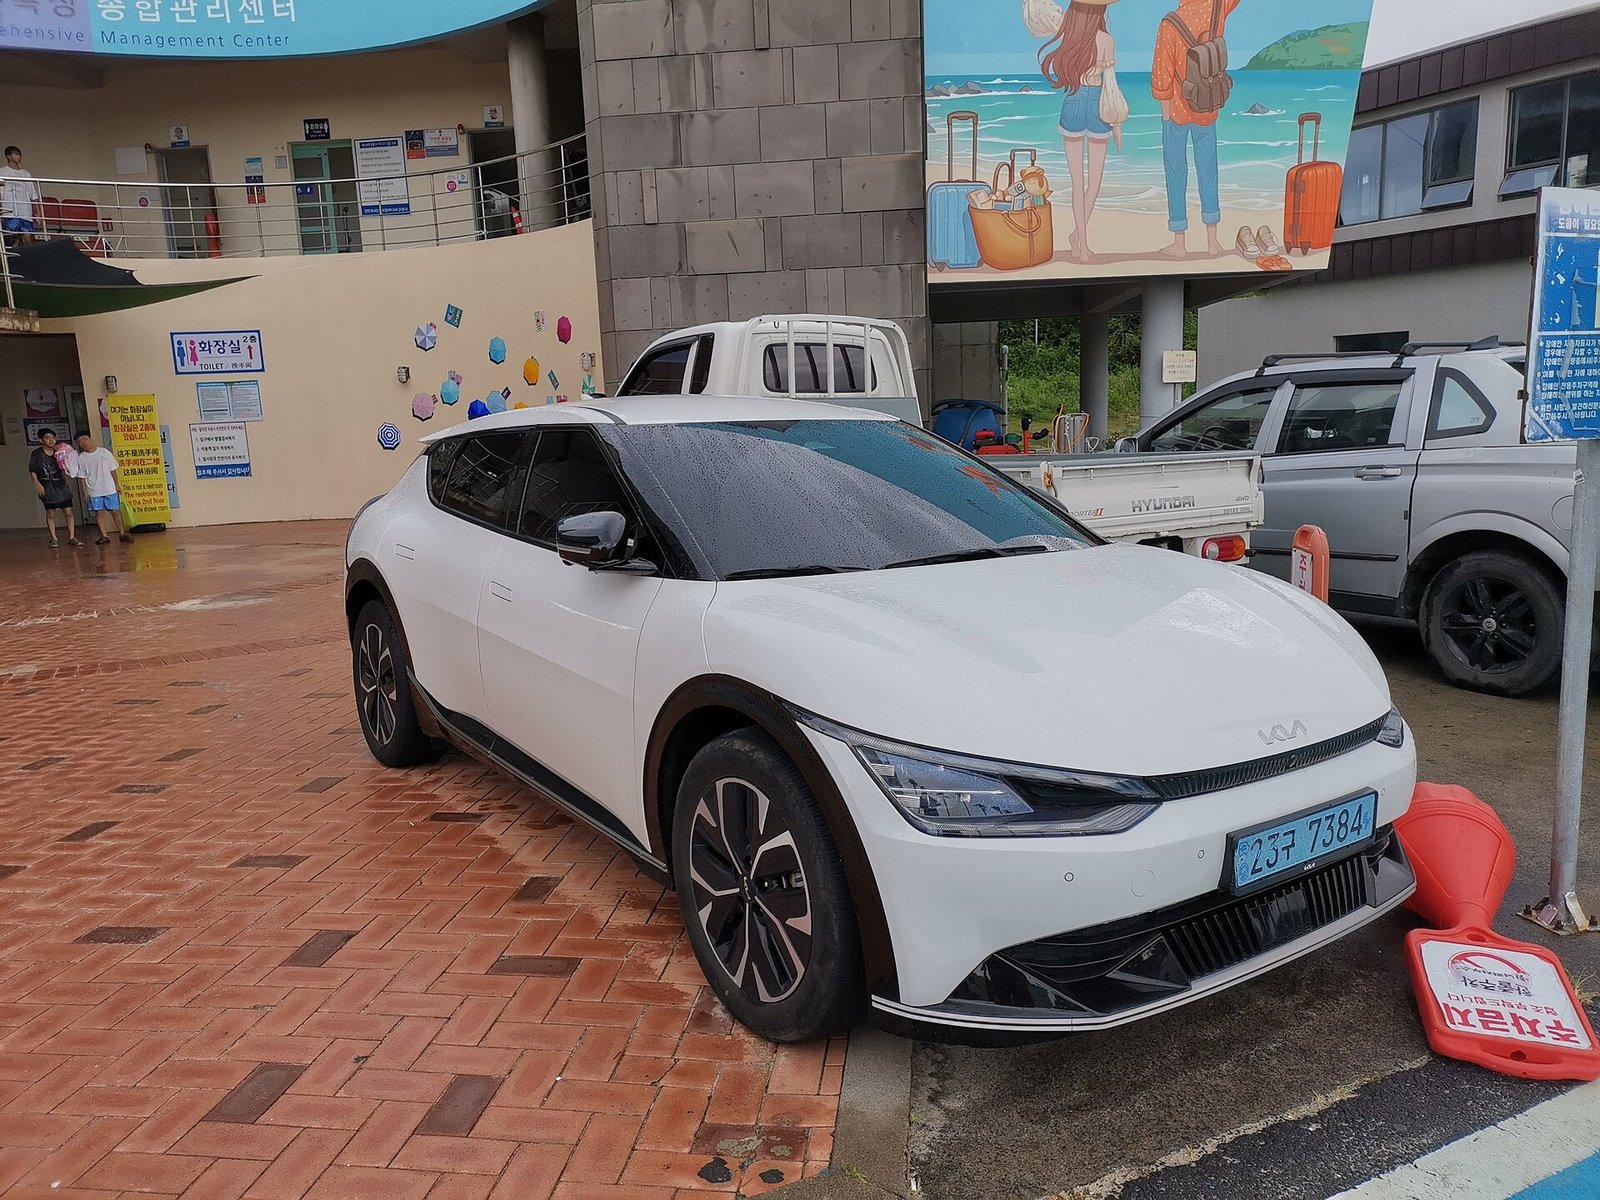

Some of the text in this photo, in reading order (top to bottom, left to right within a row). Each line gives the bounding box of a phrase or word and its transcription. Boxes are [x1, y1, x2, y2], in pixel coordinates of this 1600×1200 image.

[100, 30, 225, 48] Management
[233, 34, 290, 47] Center
[198, 335, 257, 354] 화장실 2층
[130, 405, 153, 413] 화장실이
[113, 424, 138, 432] 화장실은
[117, 448, 159, 457] 这不是洗手间
[1131, 495, 1195, 512] HYUNDAI
[1258, 720, 1307, 745] KIA
[1250, 803, 1362, 875] 23구 7384
[1447, 993, 1558, 1016] 협조 부탁드립니다
[1442, 1003, 1580, 1044] 주차금지
